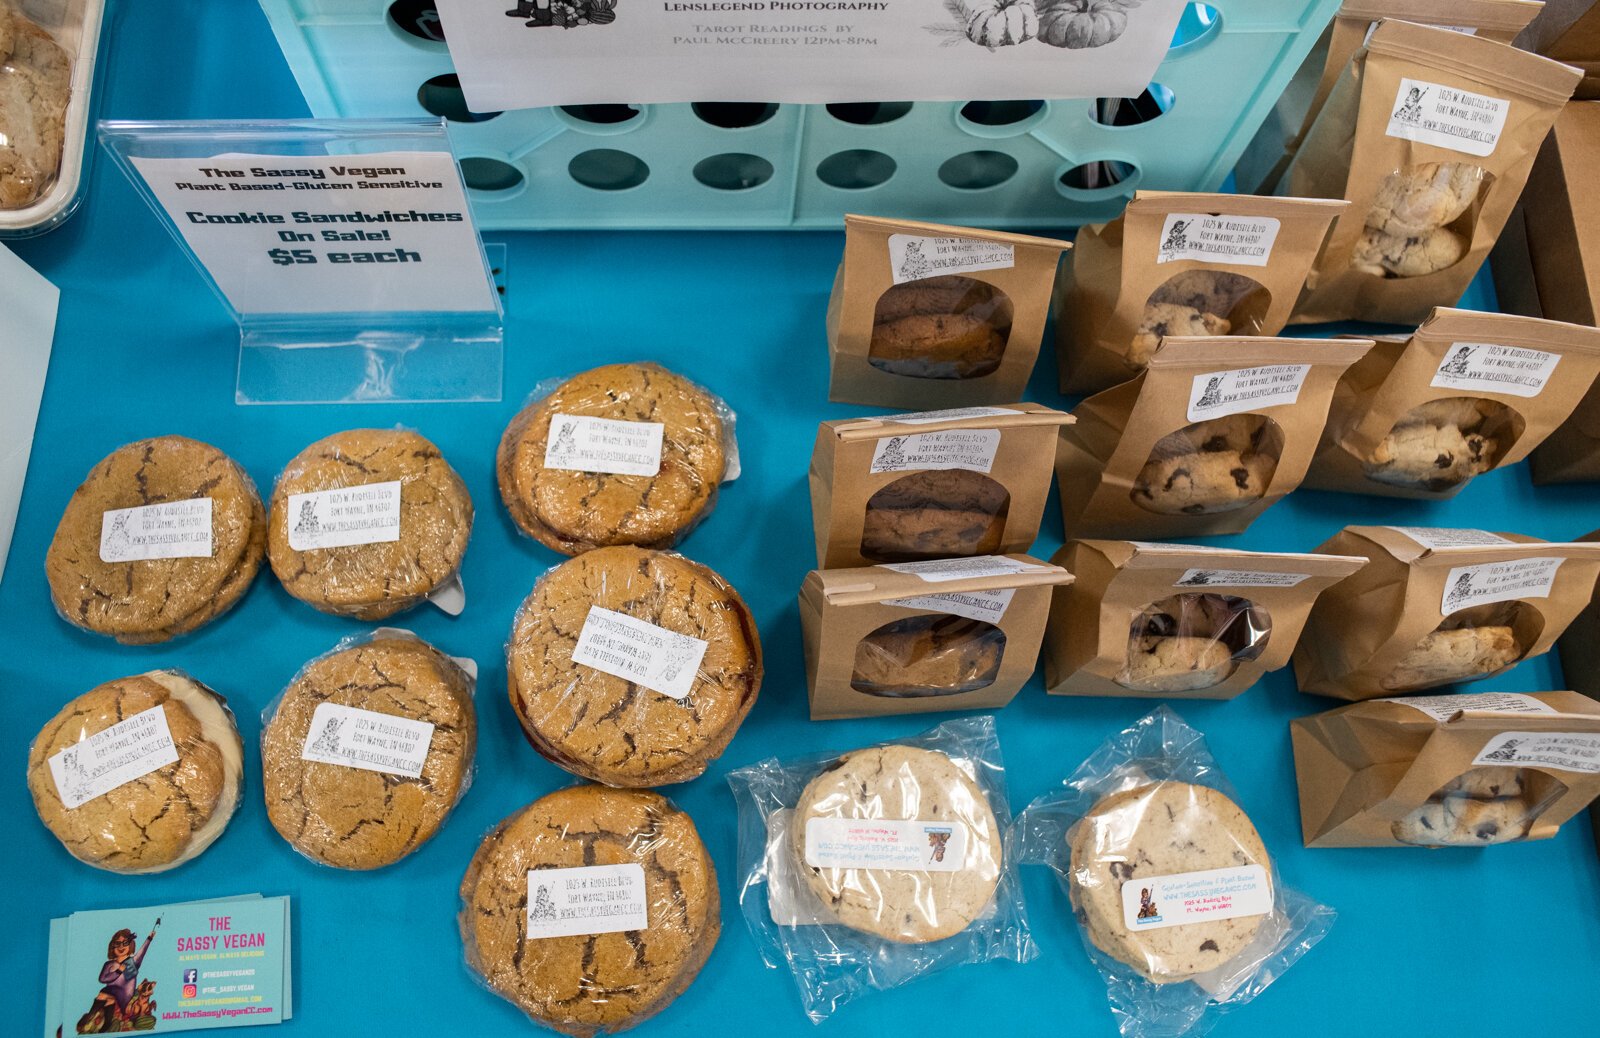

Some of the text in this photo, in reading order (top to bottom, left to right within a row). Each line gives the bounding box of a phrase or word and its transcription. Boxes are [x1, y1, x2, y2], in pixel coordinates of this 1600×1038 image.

[664, 1, 889, 11] LENSLEGEND PHOTOGRAPHY
[693, 25, 855, 33] TAROT READINGS BY
[673, 37, 711, 45] PAUL
[804, 36, 877, 45] 12PM-8PM
[199, 166, 406, 179] The Sassy Vegan
[175, 180, 443, 191] Plant Based-Gluten Sensitive
[185, 210, 464, 224] Cookie Sandwiches
[277, 229, 392, 242] On Sale!
[267, 248, 422, 266] $5 each
[209, 916, 232, 931] THE
[177, 932, 266, 952] SASSY VEGAN
